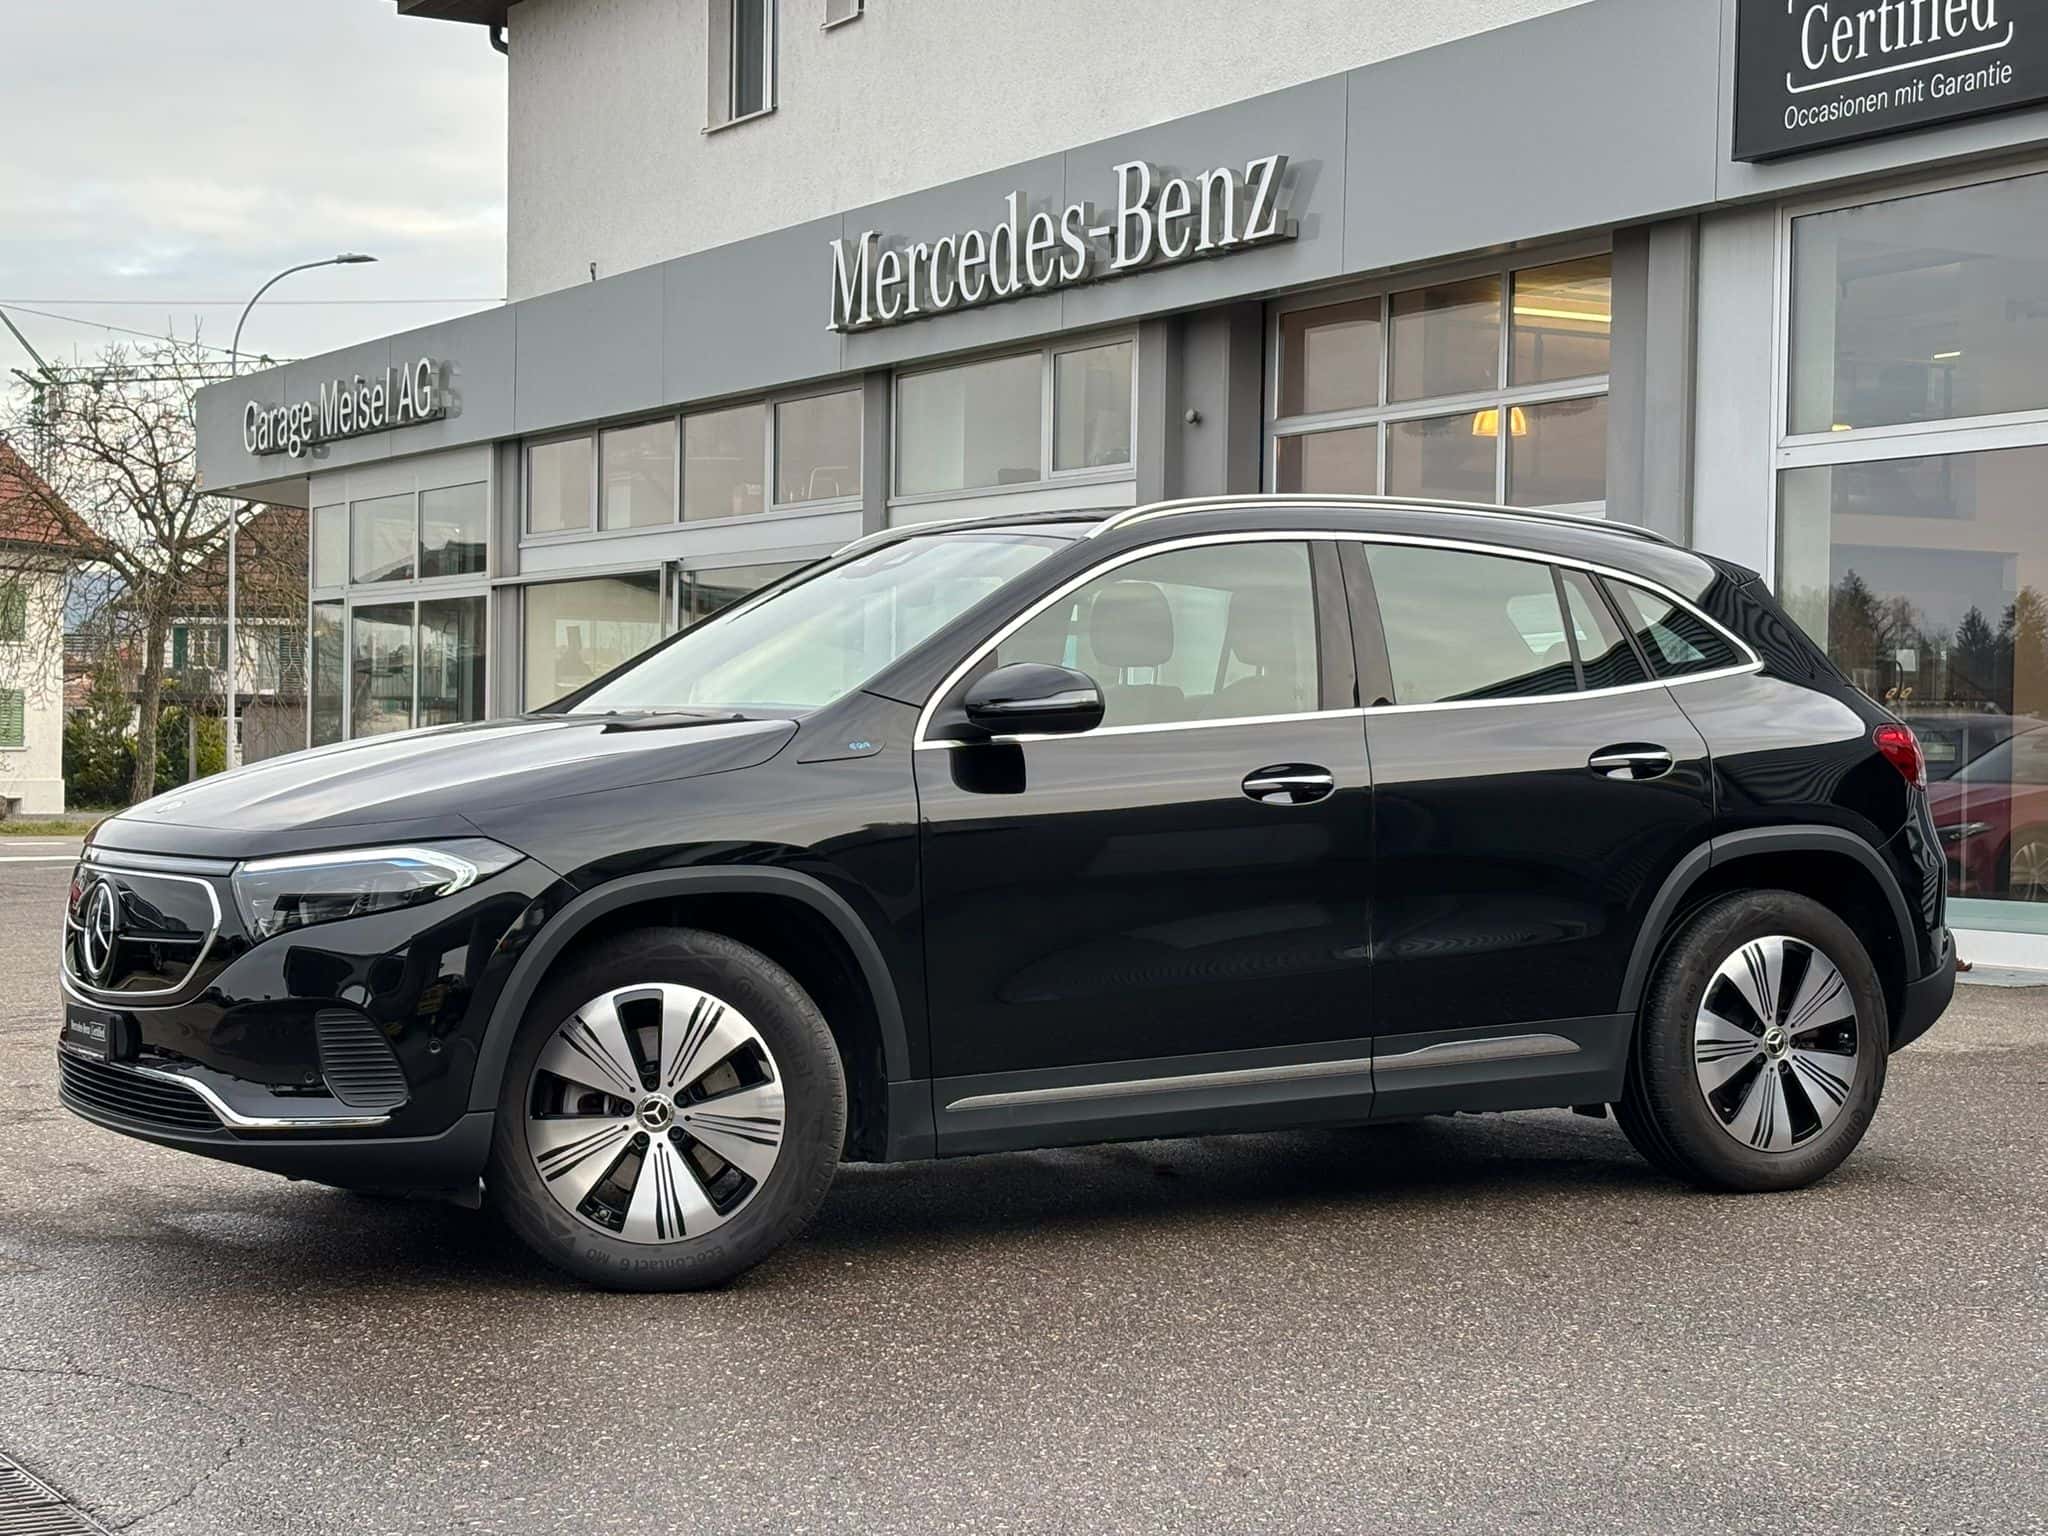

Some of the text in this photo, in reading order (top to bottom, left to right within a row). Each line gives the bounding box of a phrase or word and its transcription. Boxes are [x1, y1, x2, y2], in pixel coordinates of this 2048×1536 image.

[1784, 61, 2012, 129] Occasionen mit Garantie
[826, 154, 1290, 331] Mercedes-Benz
[243, 357, 432, 458] Garage Meisel AG
